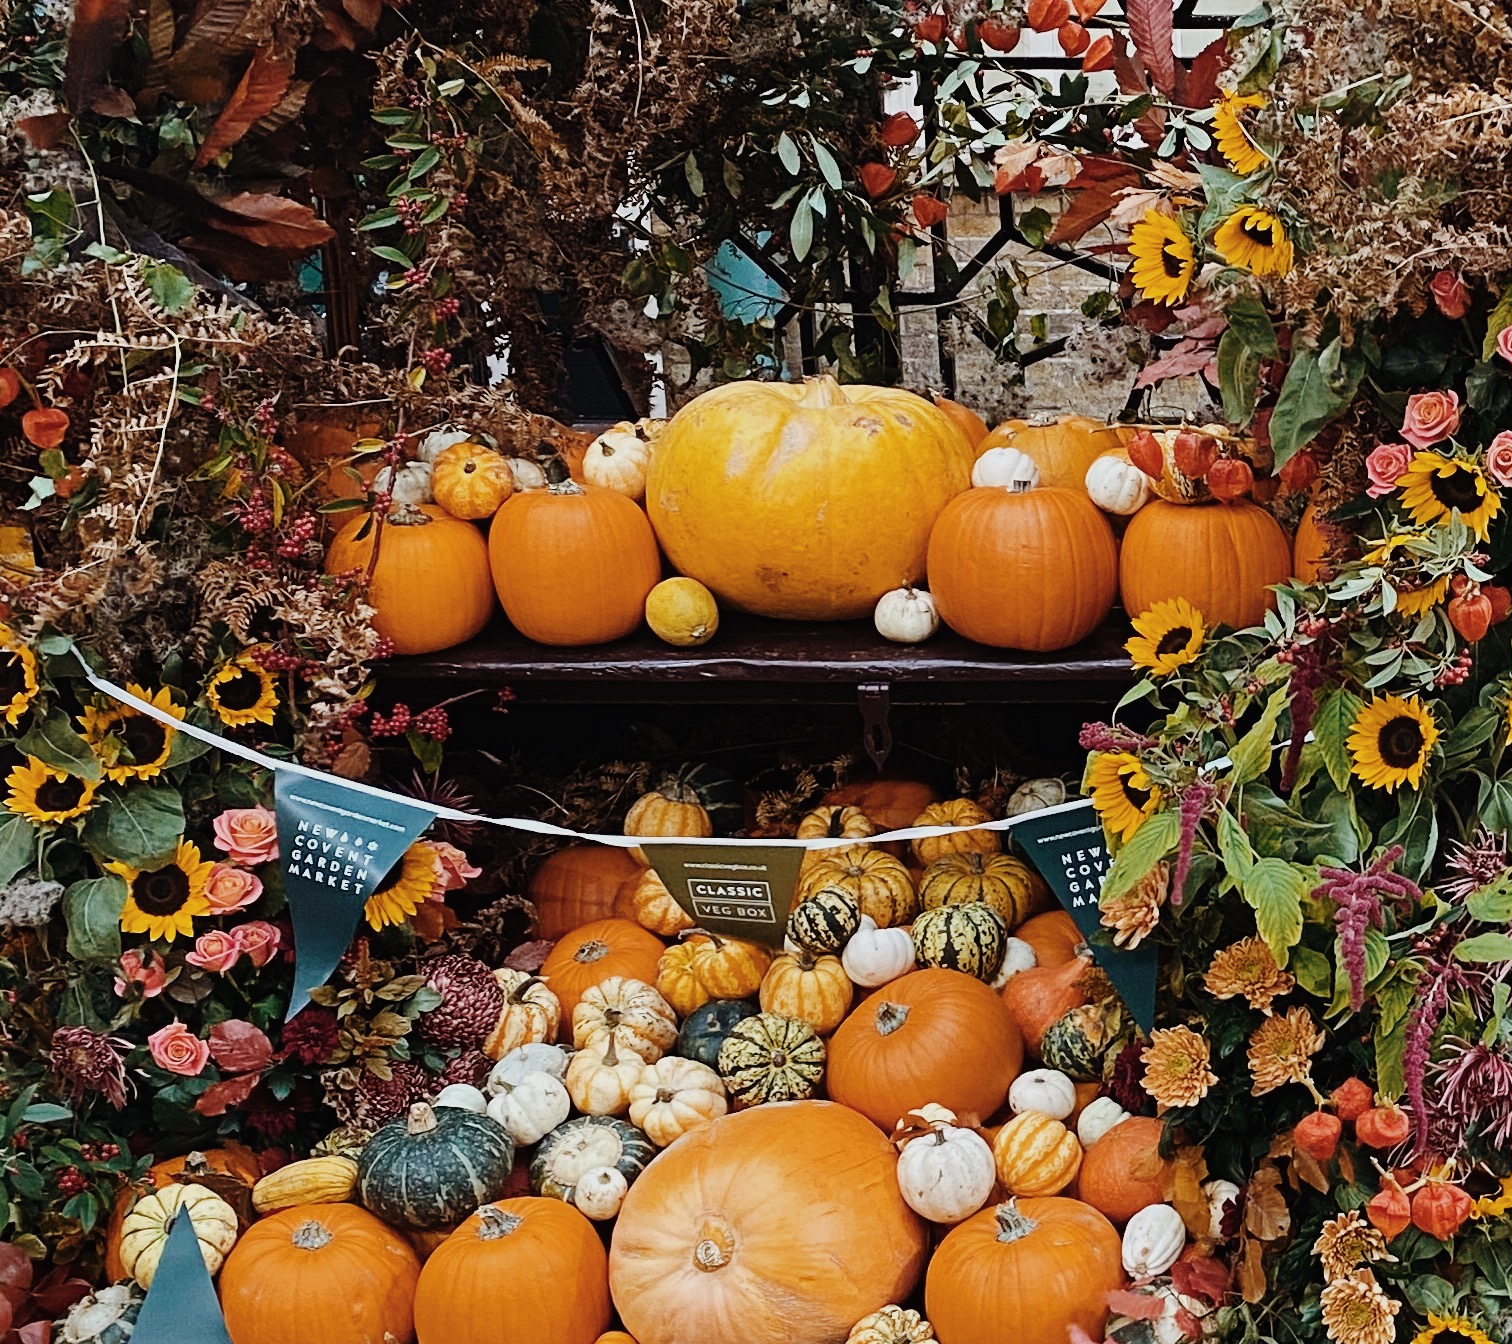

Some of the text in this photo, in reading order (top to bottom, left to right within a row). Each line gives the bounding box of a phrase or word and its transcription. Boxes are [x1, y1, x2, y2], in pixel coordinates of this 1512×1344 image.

[297, 820, 338, 839] NEW
[294, 835, 374, 866] COVENT
[1061, 846, 1101, 866] NEW
[291, 849, 368, 881] GARDEN
[288, 863, 364, 895] MARKET
[695, 884, 763, 898] CLASSIC
[701, 904, 767, 918] VEG BOX
